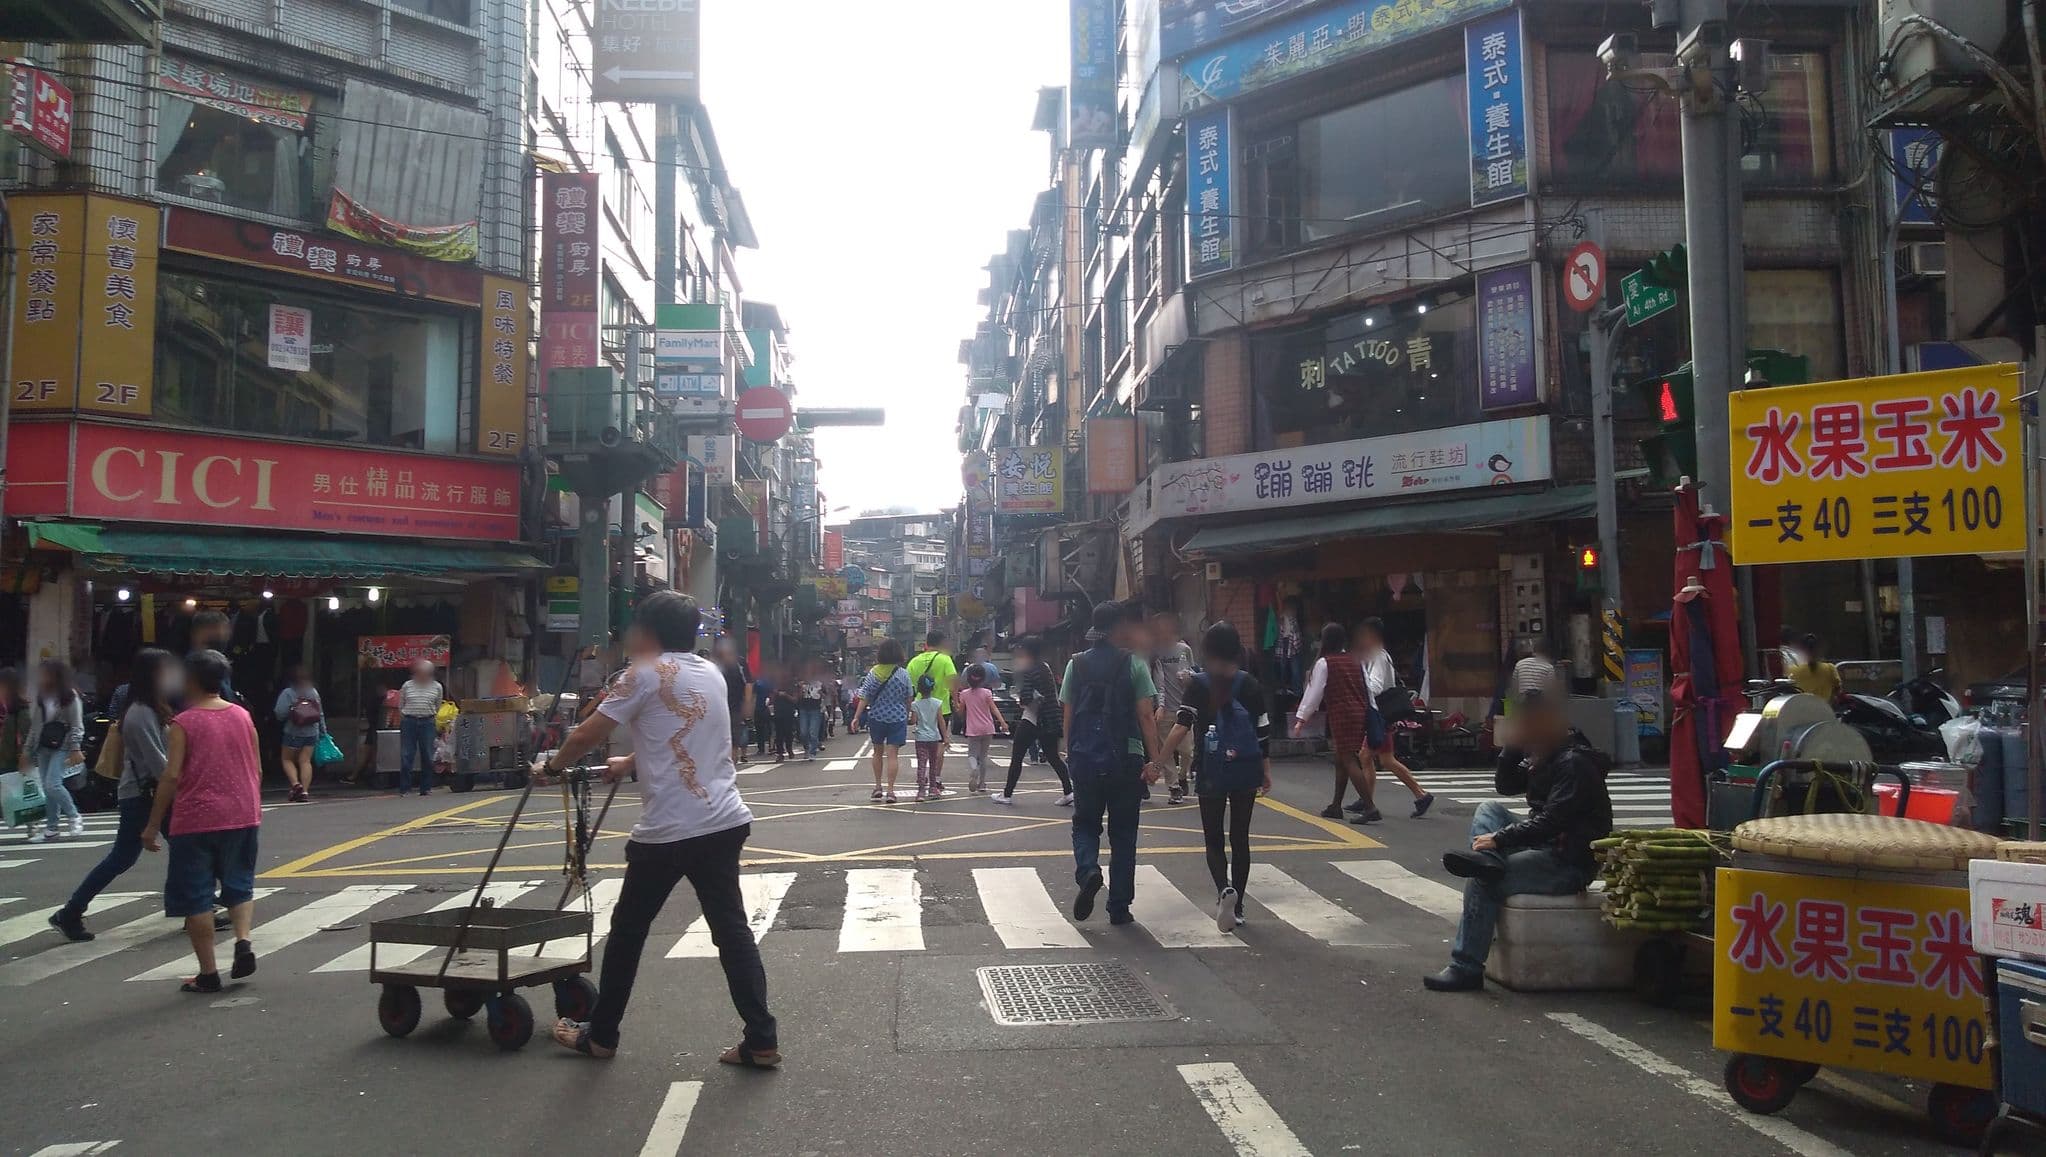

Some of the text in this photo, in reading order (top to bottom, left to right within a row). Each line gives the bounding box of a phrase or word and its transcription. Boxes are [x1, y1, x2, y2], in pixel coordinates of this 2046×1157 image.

[602, 14, 673, 32] HOTEL
[1482, 32, 1513, 188] 泰式·養生館
[1200, 126, 1220, 262] 泰式·養生館
[27, 212, 59, 322] 家常餐點
[106, 216, 138, 329] 懷舊美食
[568, 294, 593, 306] 2F
[1644, 297, 1656, 311] 4th
[1658, 290, 1670, 304] Rd
[494, 290, 515, 385] 風味特餐
[658, 337, 719, 350] FamilyMart
[1406, 337, 1432, 372] 青
[1300, 357, 1325, 390] 刺
[1330, 339, 1399, 375] TATTOO
[17, 380, 56, 400] 2F
[97, 383, 137, 404] 2F
[488, 431, 516, 449] 2F
[1747, 389, 2006, 485] 水果玉米
[1391, 446, 1464, 471] 流行鞋坊
[91, 446, 279, 511] CICI
[313, 466, 511, 507] 男仕精品流行服飾
[1254, 455, 1375, 499] 蹦蹦跳
[1730, 892, 1984, 998] 水果玉米
